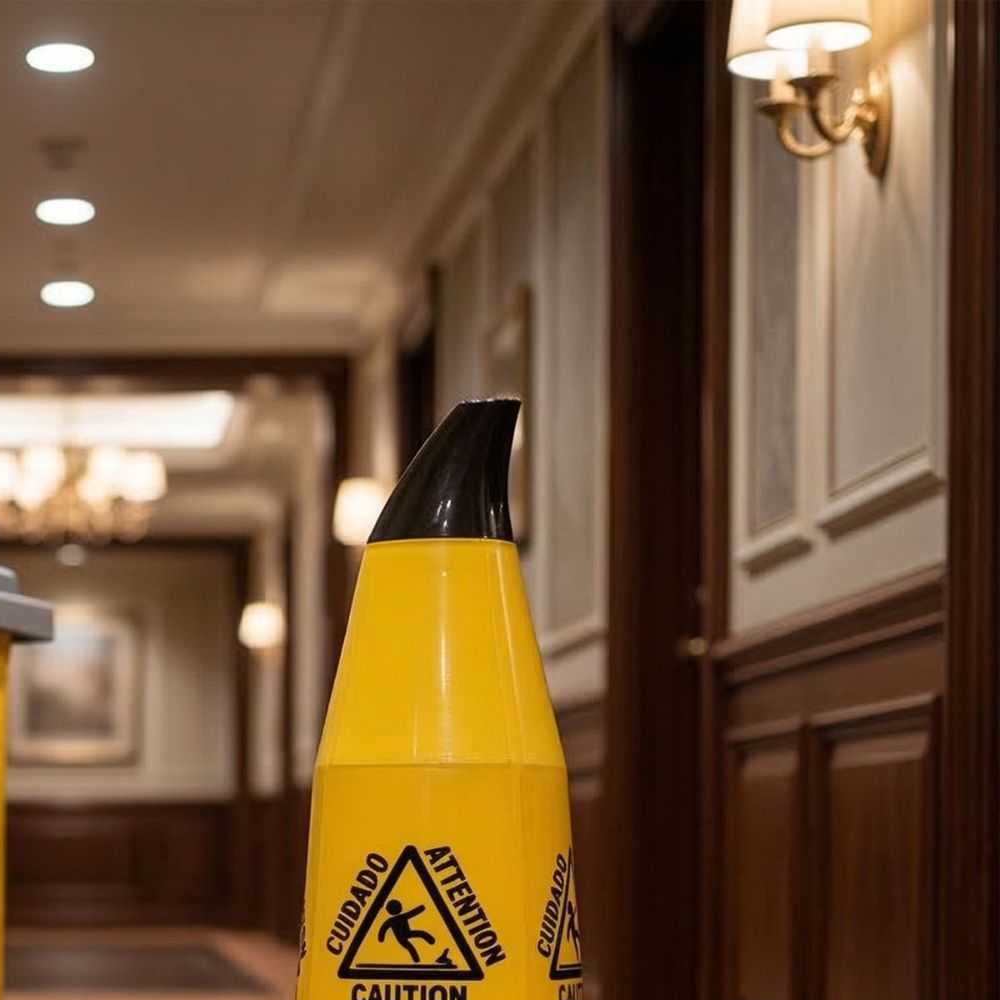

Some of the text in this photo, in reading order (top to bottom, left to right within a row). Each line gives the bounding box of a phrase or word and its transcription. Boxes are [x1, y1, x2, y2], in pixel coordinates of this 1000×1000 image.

[326, 851, 389, 956] CUIDADO
[424, 845, 507, 968] ATTENTION
[537, 853, 567, 959] CUIDADO
